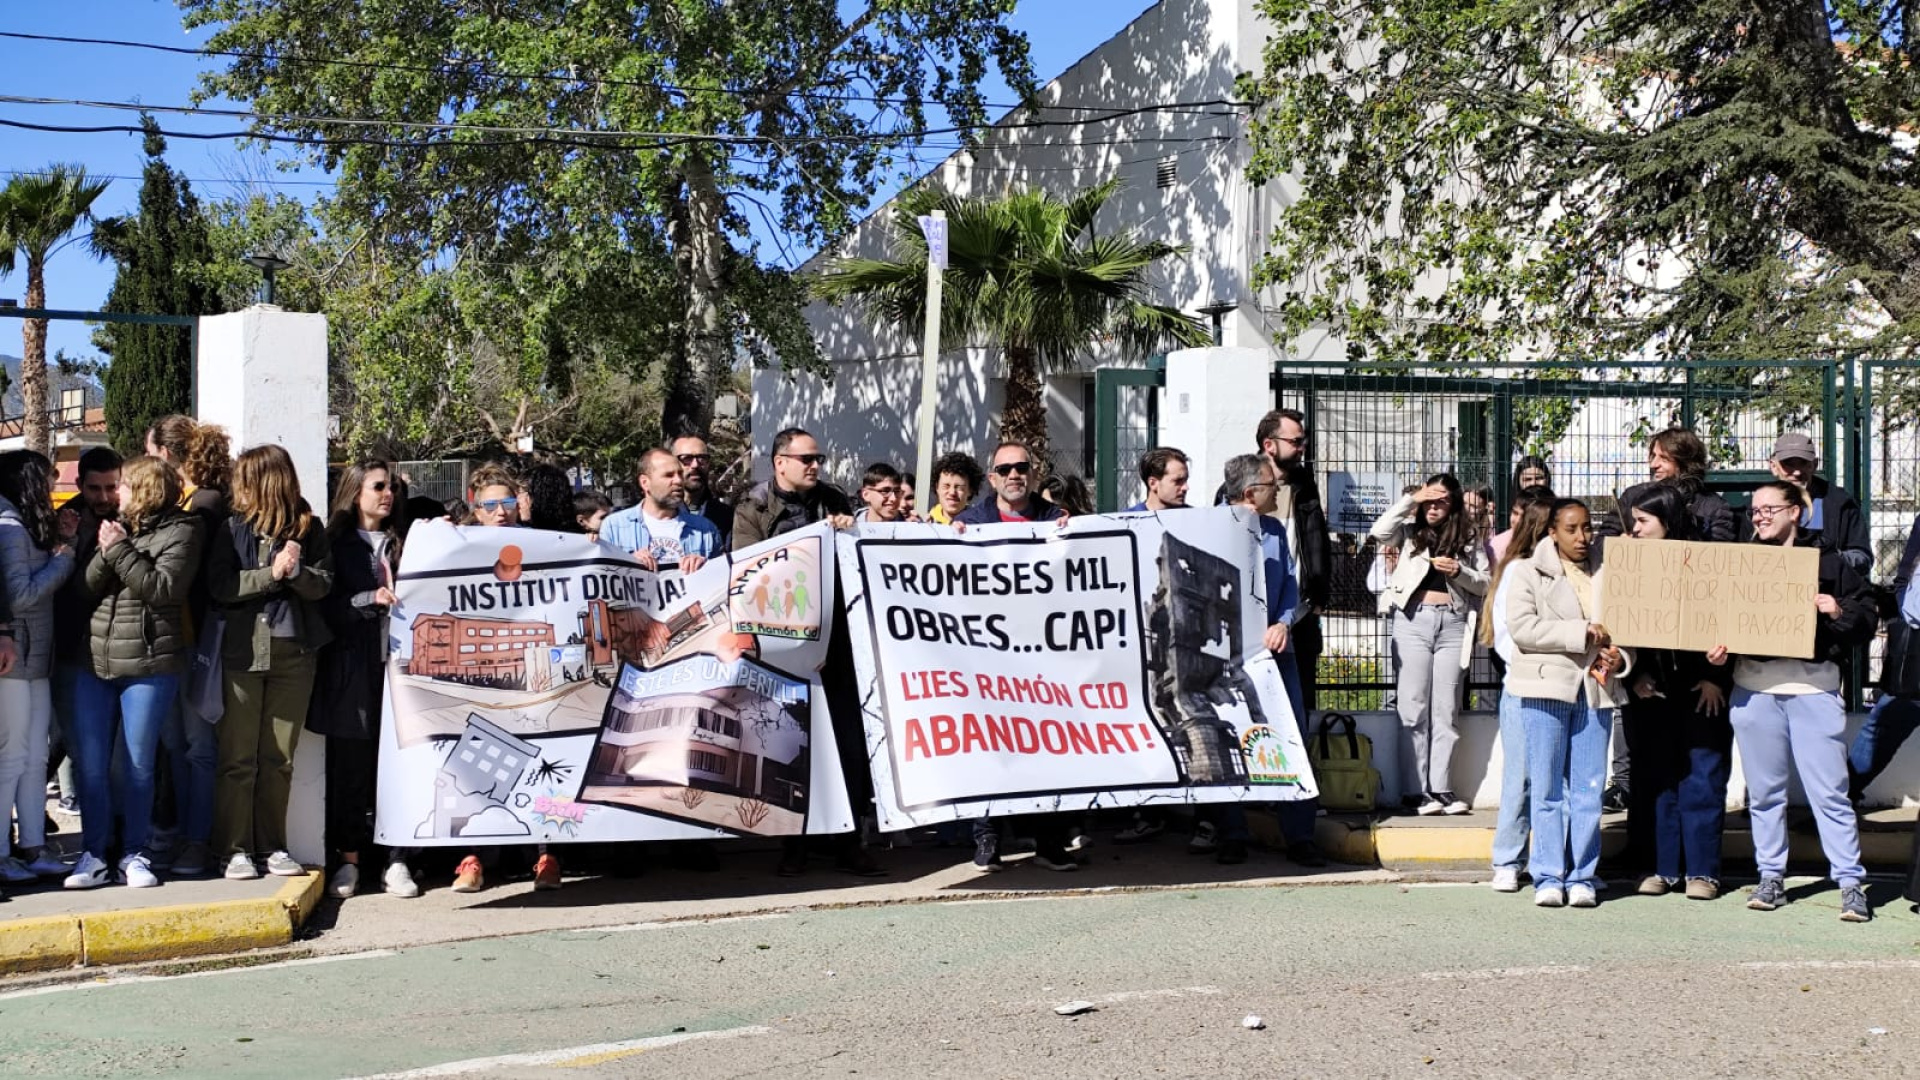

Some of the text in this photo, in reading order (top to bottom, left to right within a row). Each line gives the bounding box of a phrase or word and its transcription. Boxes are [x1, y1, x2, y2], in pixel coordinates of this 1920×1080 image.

[729, 548, 788, 596] AMPA
[880, 556, 1127, 596] PROMESES MIL,
[1608, 574, 1645, 599] QUE
[1732, 580, 1816, 605] NUESTRO
[448, 574, 688, 611] INSTITUT DIGNE, JA!
[736, 621, 818, 638] IES Ramón Cid
[1604, 604, 1806, 637] CENTRO DA PAVOR
[623, 670, 666, 697] ESTE
[671, 665, 694, 685] ES
[701, 661, 732, 682] UN
[900, 670, 1129, 710] L'IES RAMÓN CID
[904, 713, 1156, 763] ABANDONAT!
[1242, 726, 1270, 757] AMPA
